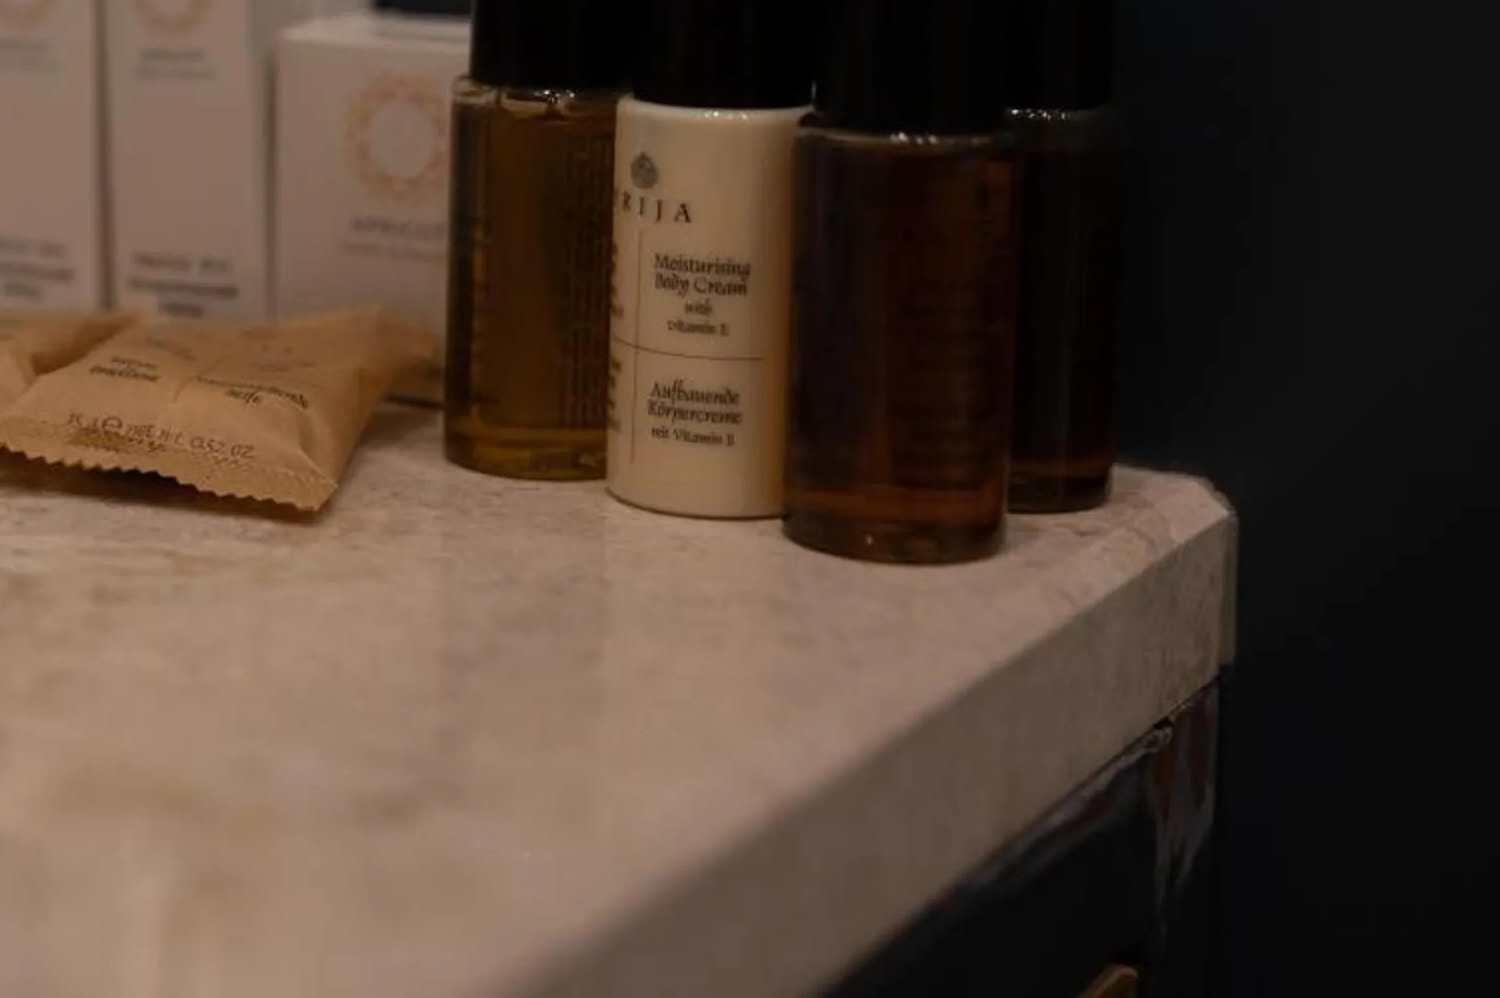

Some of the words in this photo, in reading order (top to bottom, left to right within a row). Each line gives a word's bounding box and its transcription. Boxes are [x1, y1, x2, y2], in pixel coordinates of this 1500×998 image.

[614, 190, 692, 223] RIJA
[693, 277, 748, 296] Cream
[649, 378, 740, 405] Aufbauende
[647, 399, 743, 425] Körpercreme
[672, 428, 724, 444] Vitamin
